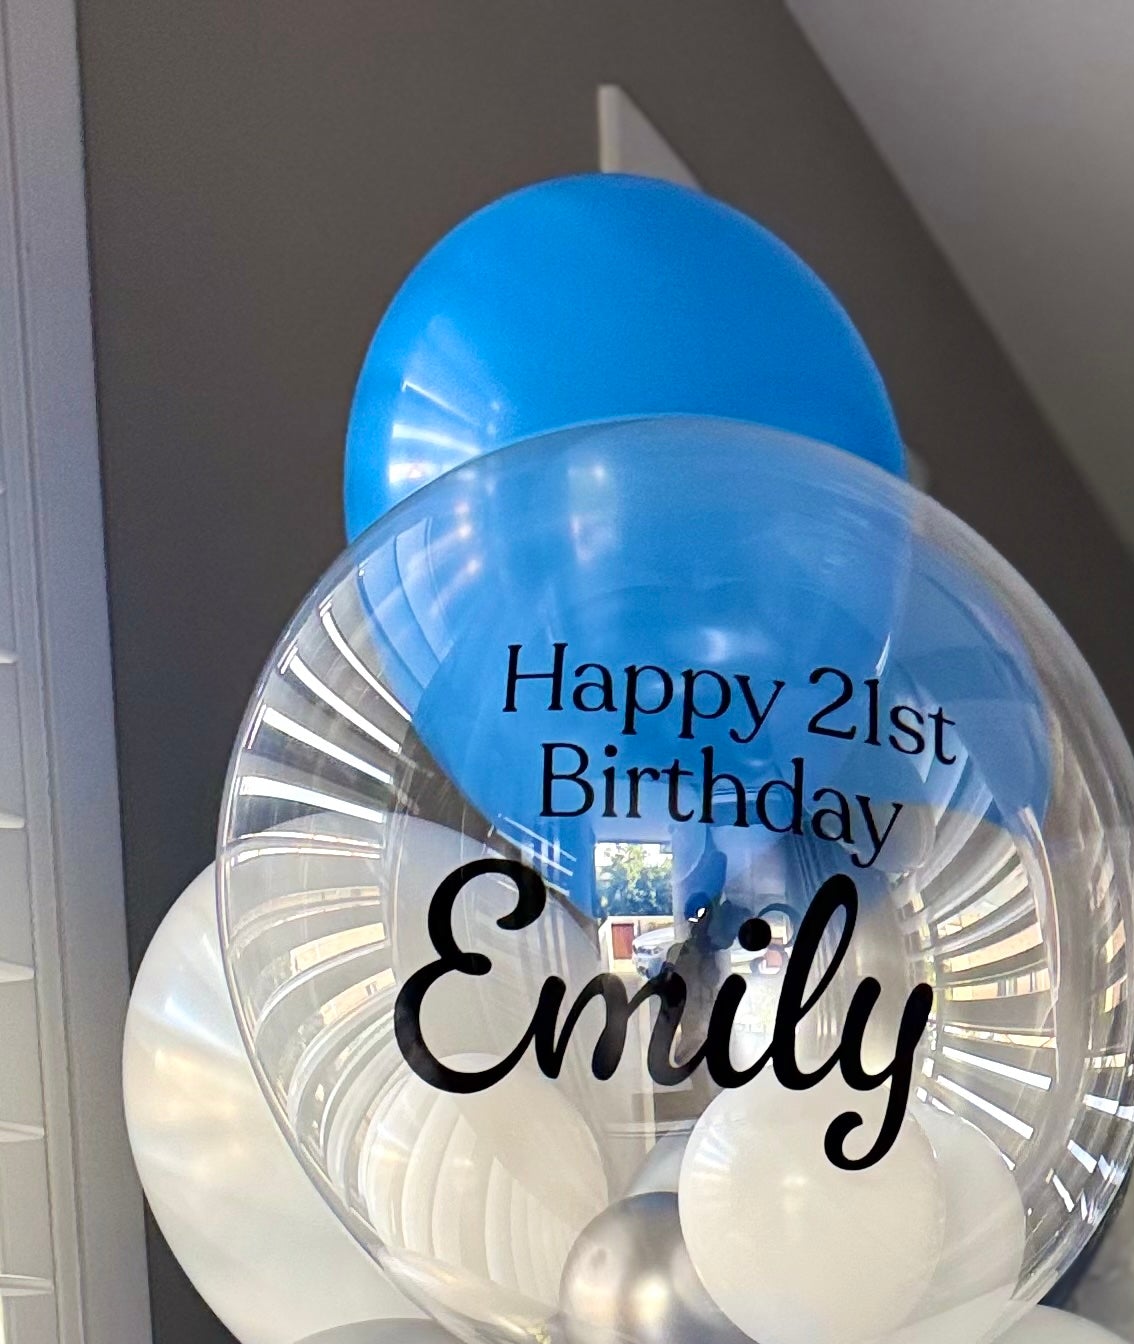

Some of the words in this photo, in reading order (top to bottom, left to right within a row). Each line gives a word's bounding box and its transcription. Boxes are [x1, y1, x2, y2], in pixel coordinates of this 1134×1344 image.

[502, 642, 785, 744] Happy
[807, 667, 957, 765] 21st
[539, 742, 904, 868] Birthday
[394, 857, 934, 1171] Emily
